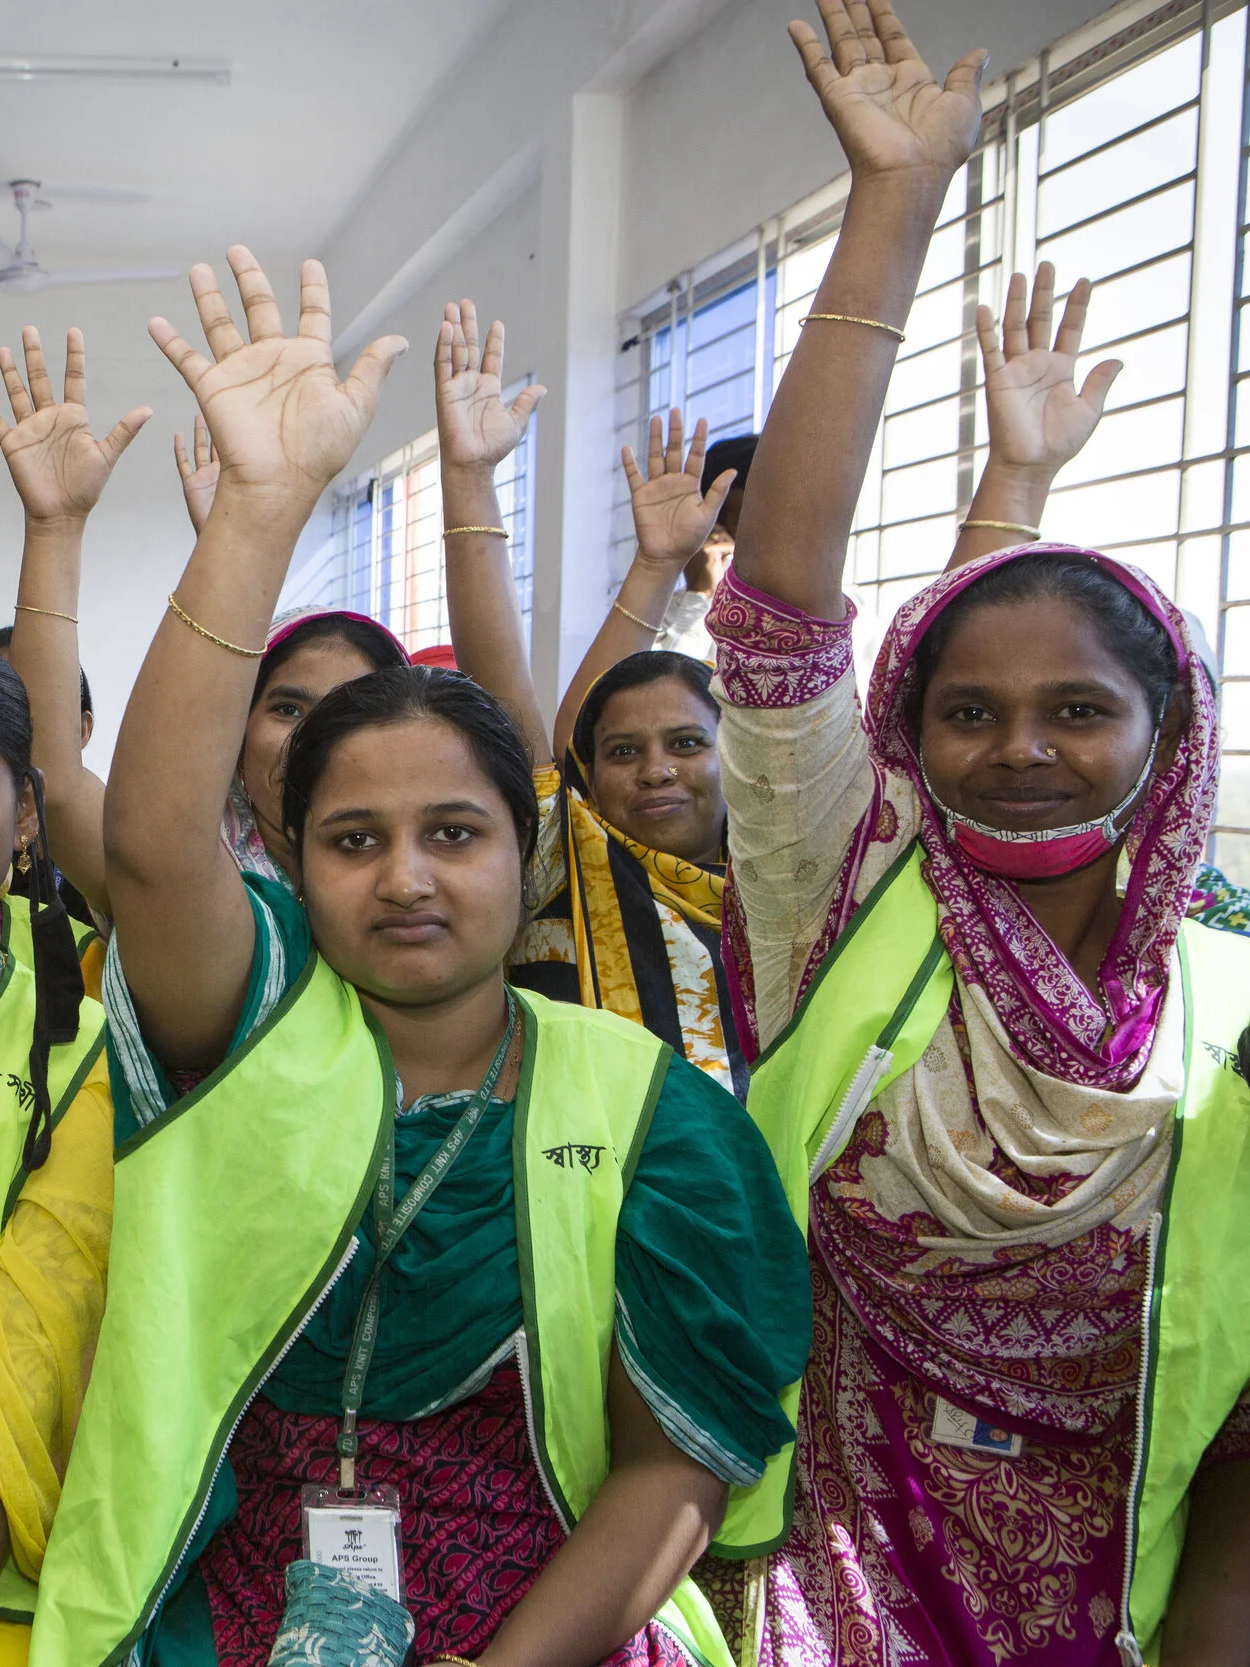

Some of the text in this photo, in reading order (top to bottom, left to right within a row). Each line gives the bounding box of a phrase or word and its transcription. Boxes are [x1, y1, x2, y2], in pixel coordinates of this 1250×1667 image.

[446, 1130, 464, 1152] APS
[430, 1152, 450, 1173] KNIT
[541, 1142, 607, 1175] স্বাস্থ্য
[378, 1184, 390, 1206] APS
[392, 1174, 434, 1226] COMPOSITE
[354, 1347, 368, 1370] KNIT
[348, 1374, 362, 1396] APS
[352, 1554, 378, 1563] Group
